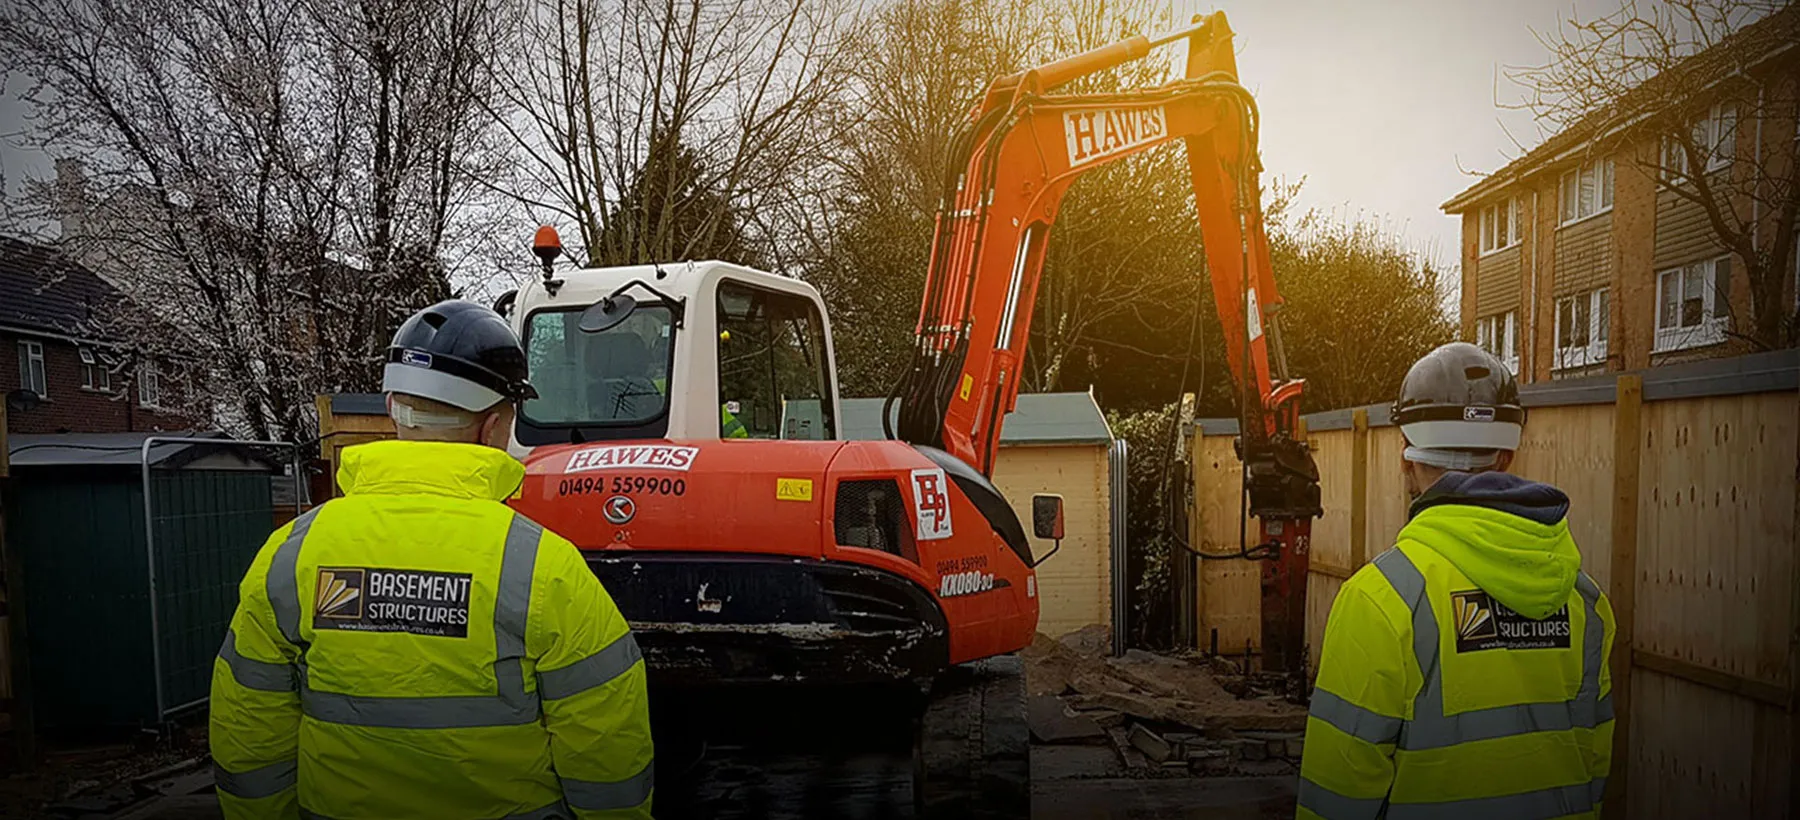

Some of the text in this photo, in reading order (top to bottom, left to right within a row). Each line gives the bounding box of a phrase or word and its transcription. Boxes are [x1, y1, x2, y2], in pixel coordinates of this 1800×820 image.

[1069, 106, 1161, 160] HAWES
[568, 448, 693, 470] HAWES
[559, 476, 686, 496] 01494 559900
[370, 572, 470, 602] BASEMENT
[368, 602, 467, 625] STRUCTURES
